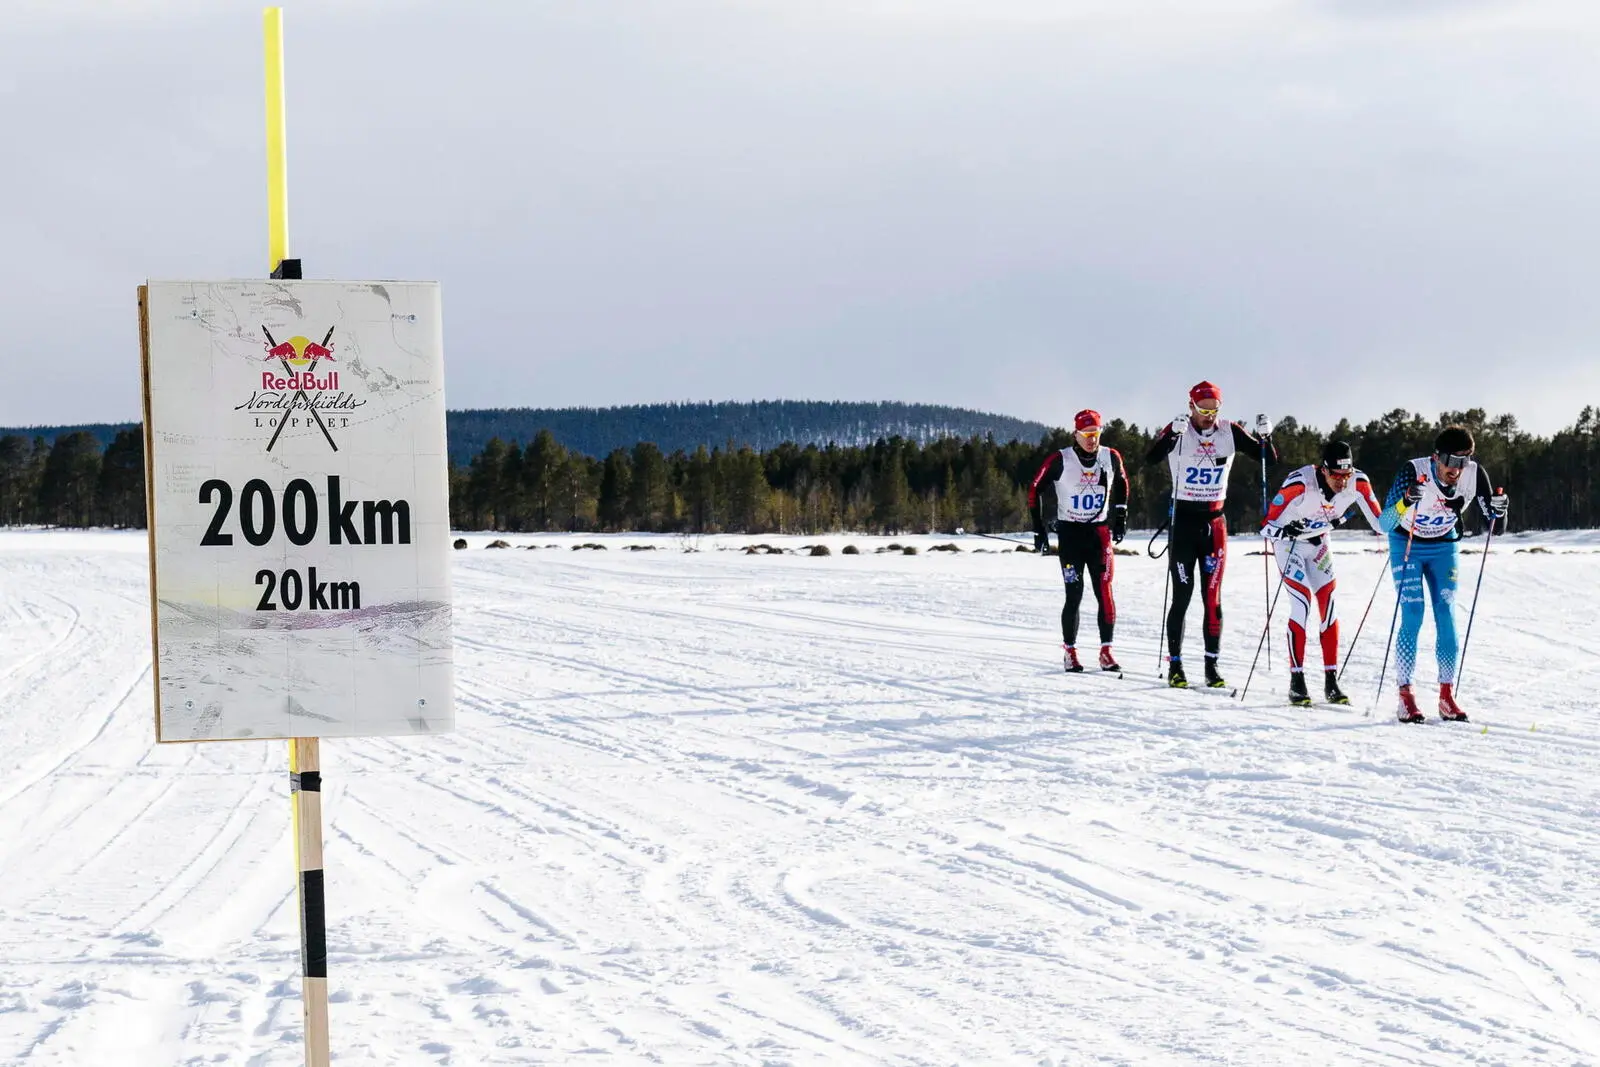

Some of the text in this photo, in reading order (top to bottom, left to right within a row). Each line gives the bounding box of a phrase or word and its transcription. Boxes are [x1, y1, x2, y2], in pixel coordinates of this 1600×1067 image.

[263, 372, 338, 390] Red Bull
[255, 418, 349, 428] LOPPET
[1186, 466, 1223, 485] 257
[1071, 494, 1104, 510] 103
